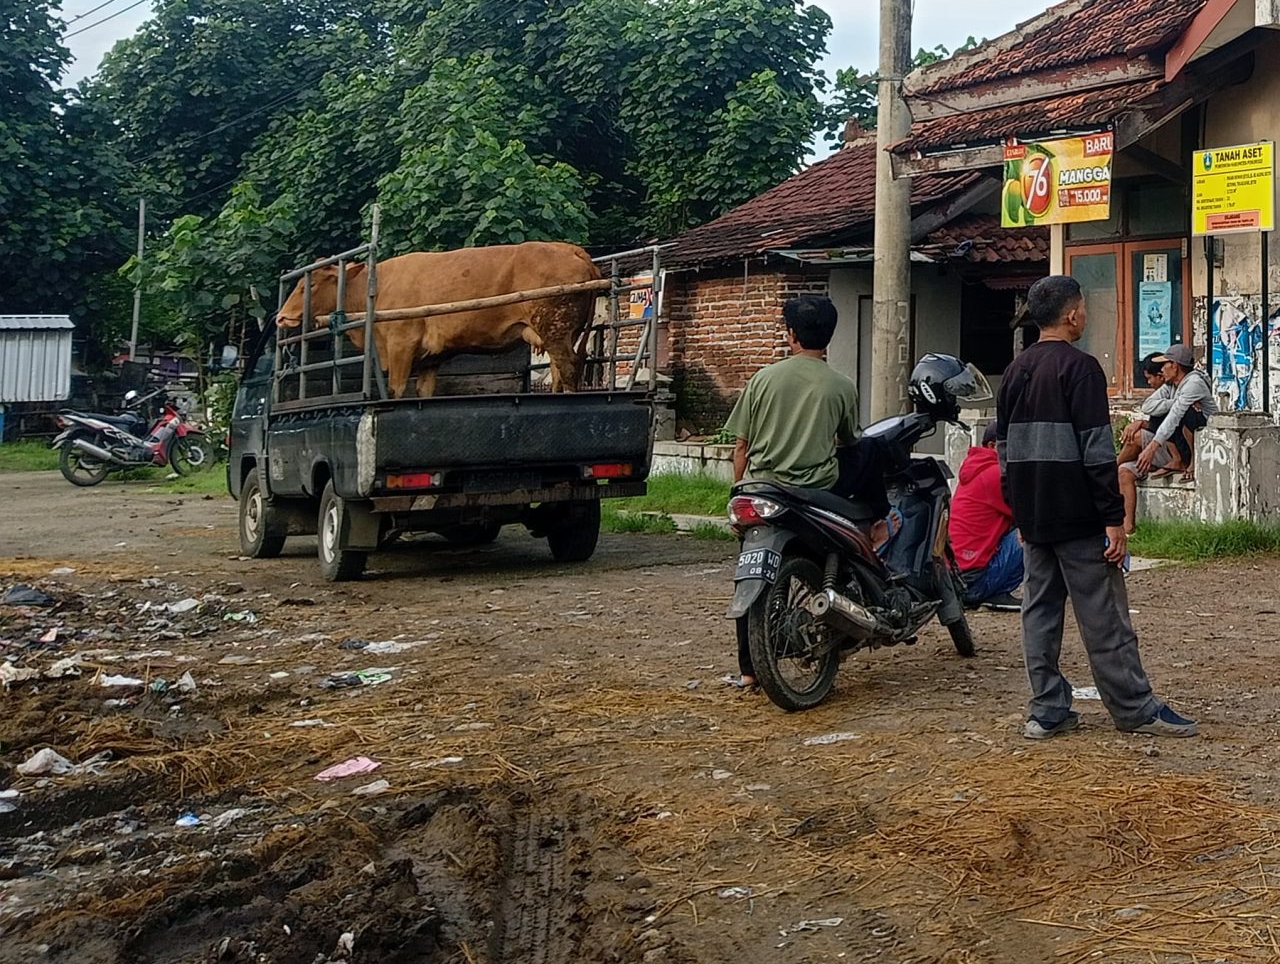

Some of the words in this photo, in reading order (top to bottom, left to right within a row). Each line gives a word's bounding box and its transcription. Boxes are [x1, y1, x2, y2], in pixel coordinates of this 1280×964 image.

[1086, 136, 1113, 153] BARU
[1215, 150, 1241, 162] TANAH
[1242, 147, 1263, 159] ASET
[1026, 156, 1050, 210] 76
[1059, 166, 1110, 186] MANGGA
[738, 551, 764, 566] 5020
